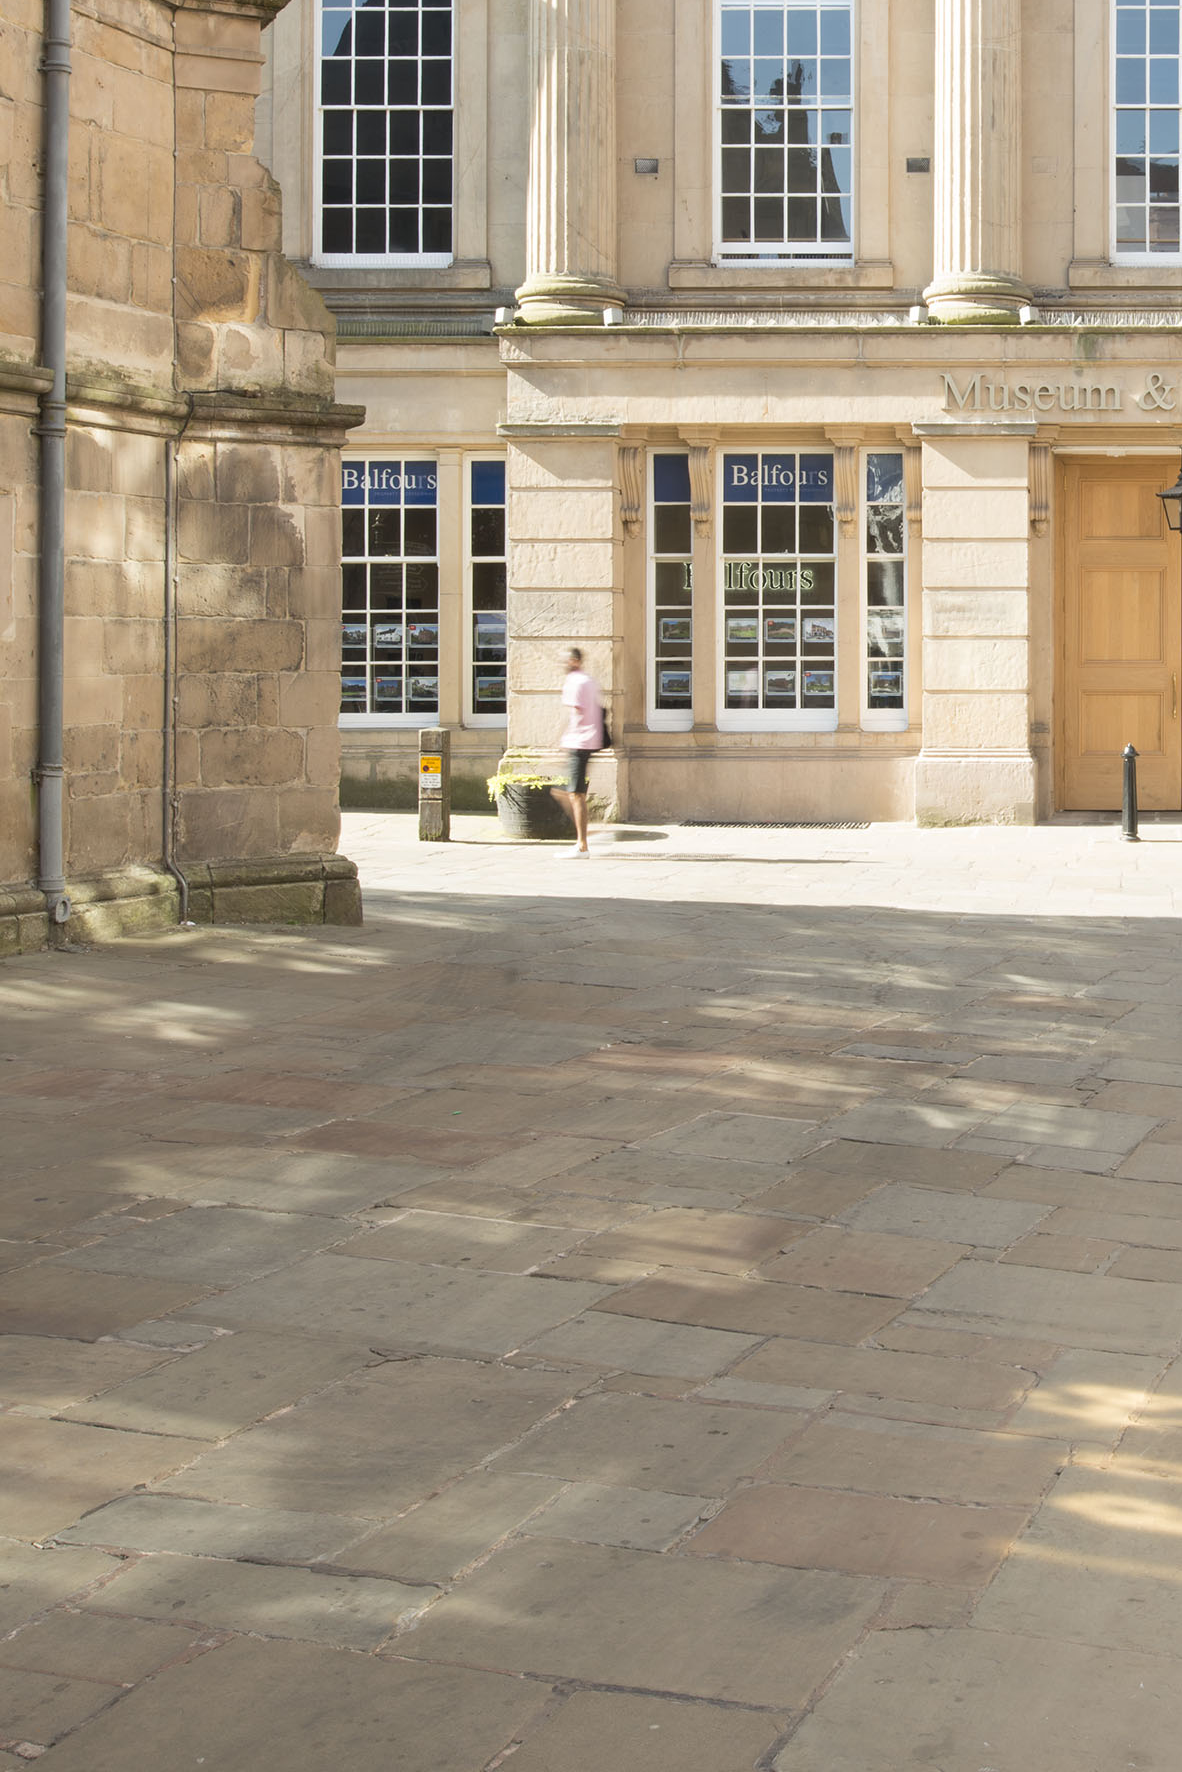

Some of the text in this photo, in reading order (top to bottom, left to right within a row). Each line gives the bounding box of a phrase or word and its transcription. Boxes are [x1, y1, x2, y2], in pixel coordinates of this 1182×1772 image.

[940, 372, 1124, 411] Museum
[1137, 372, 1177, 412] &
[342, 468, 437, 490] Balfours
[731, 464, 828, 486] Balfours
